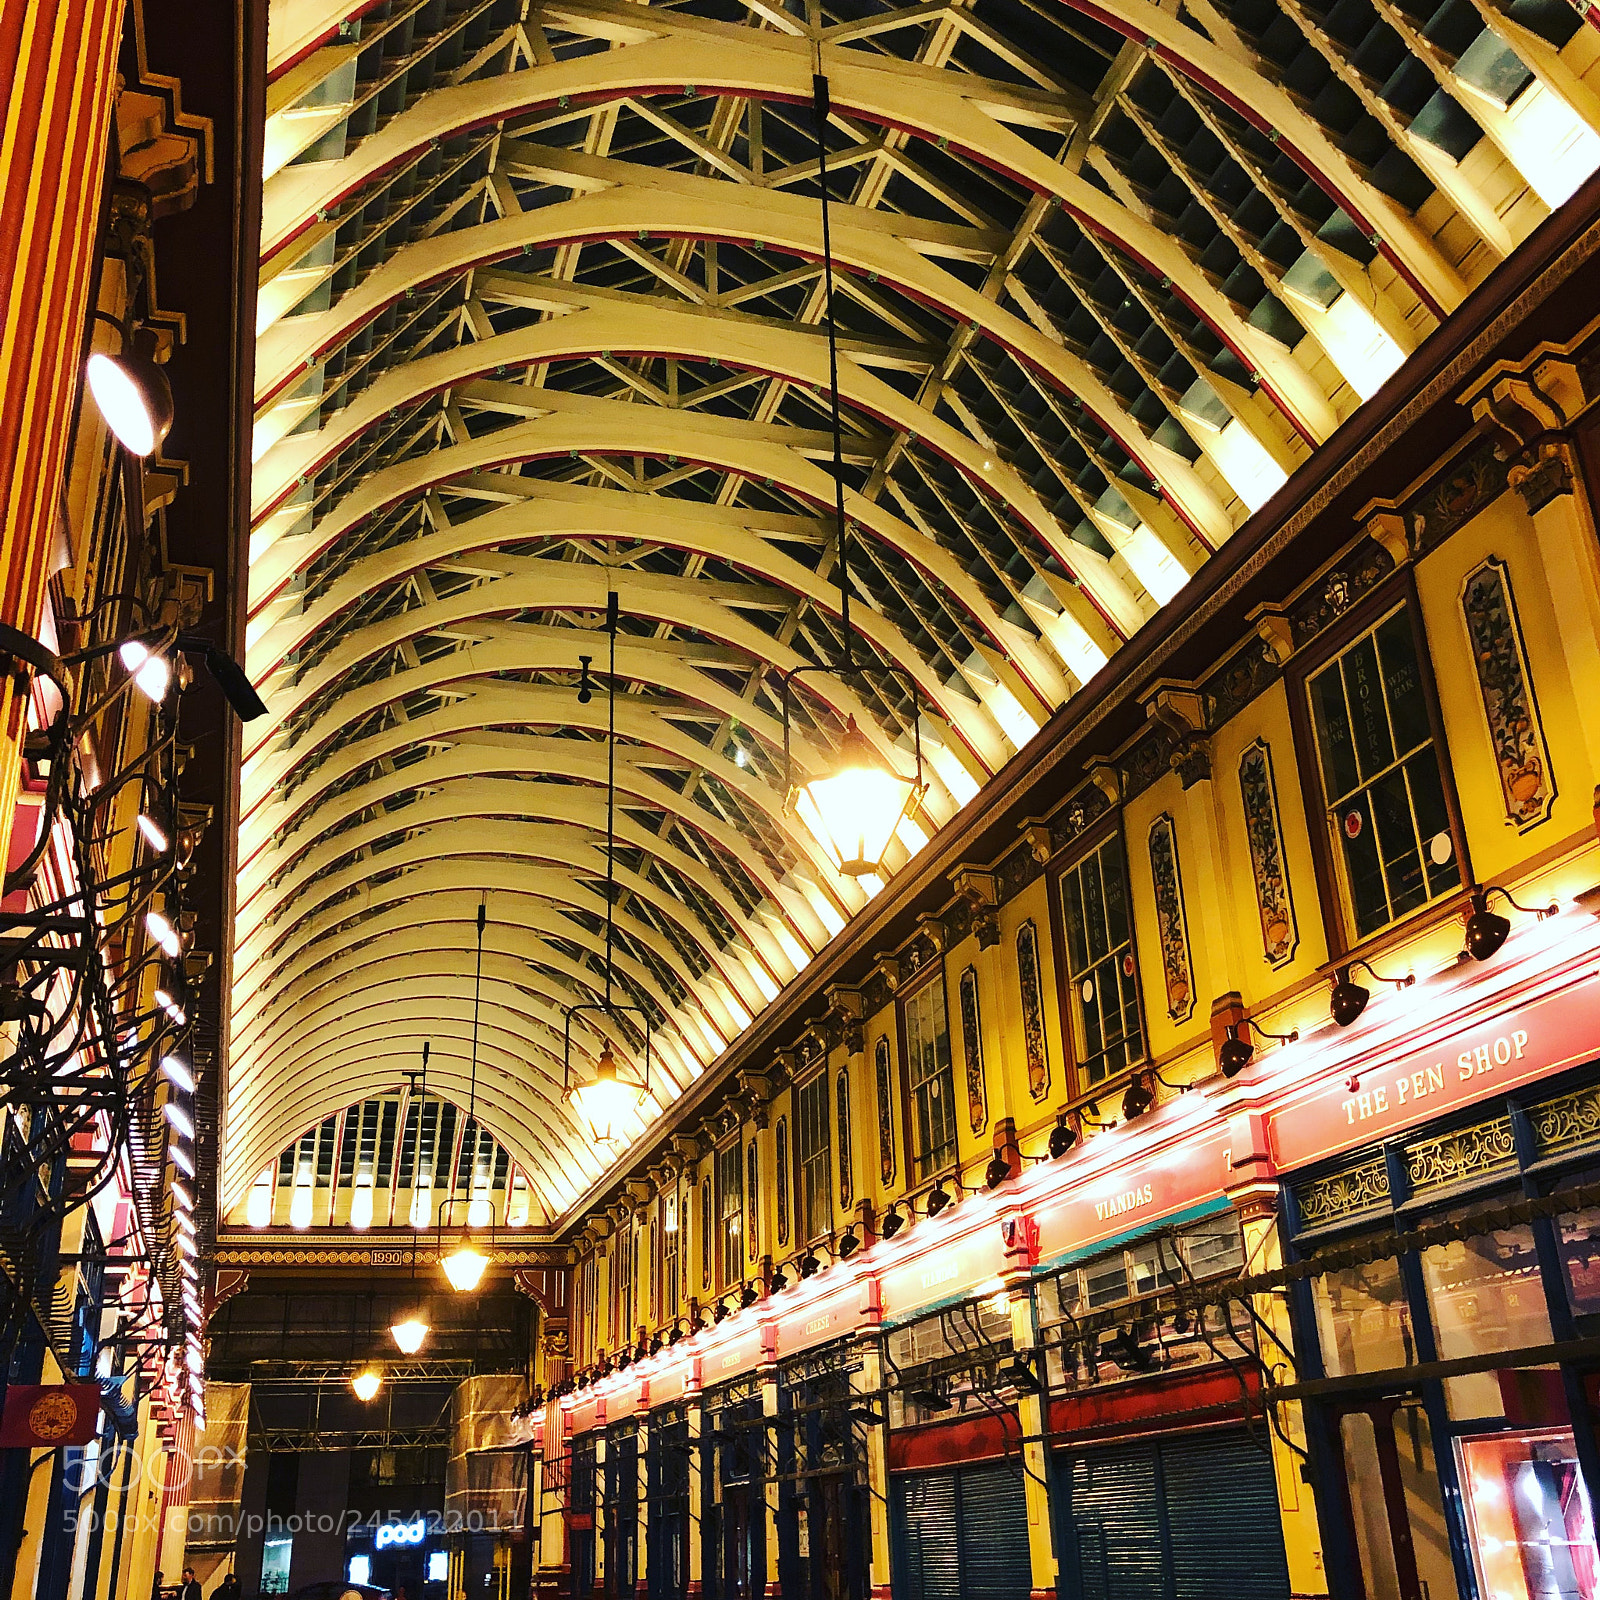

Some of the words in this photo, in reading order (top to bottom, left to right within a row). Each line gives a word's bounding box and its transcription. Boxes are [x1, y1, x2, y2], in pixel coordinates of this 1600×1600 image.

[1388, 663, 1415, 688] WINE
[1393, 679, 1415, 700] BAR
[1354, 652, 1381, 766] BROKERS
[1342, 1086, 1389, 1124] THE
[1396, 1063, 1445, 1105] PEN
[1457, 1030, 1529, 1081] SHOP
[1222, 1148, 1233, 1172] 7
[1095, 1184, 1153, 1221] VIANDAS
[373, 1252, 400, 1263] 1990
[805, 1314, 830, 1336] CHEESE
[376, 1519, 425, 1549] pod
